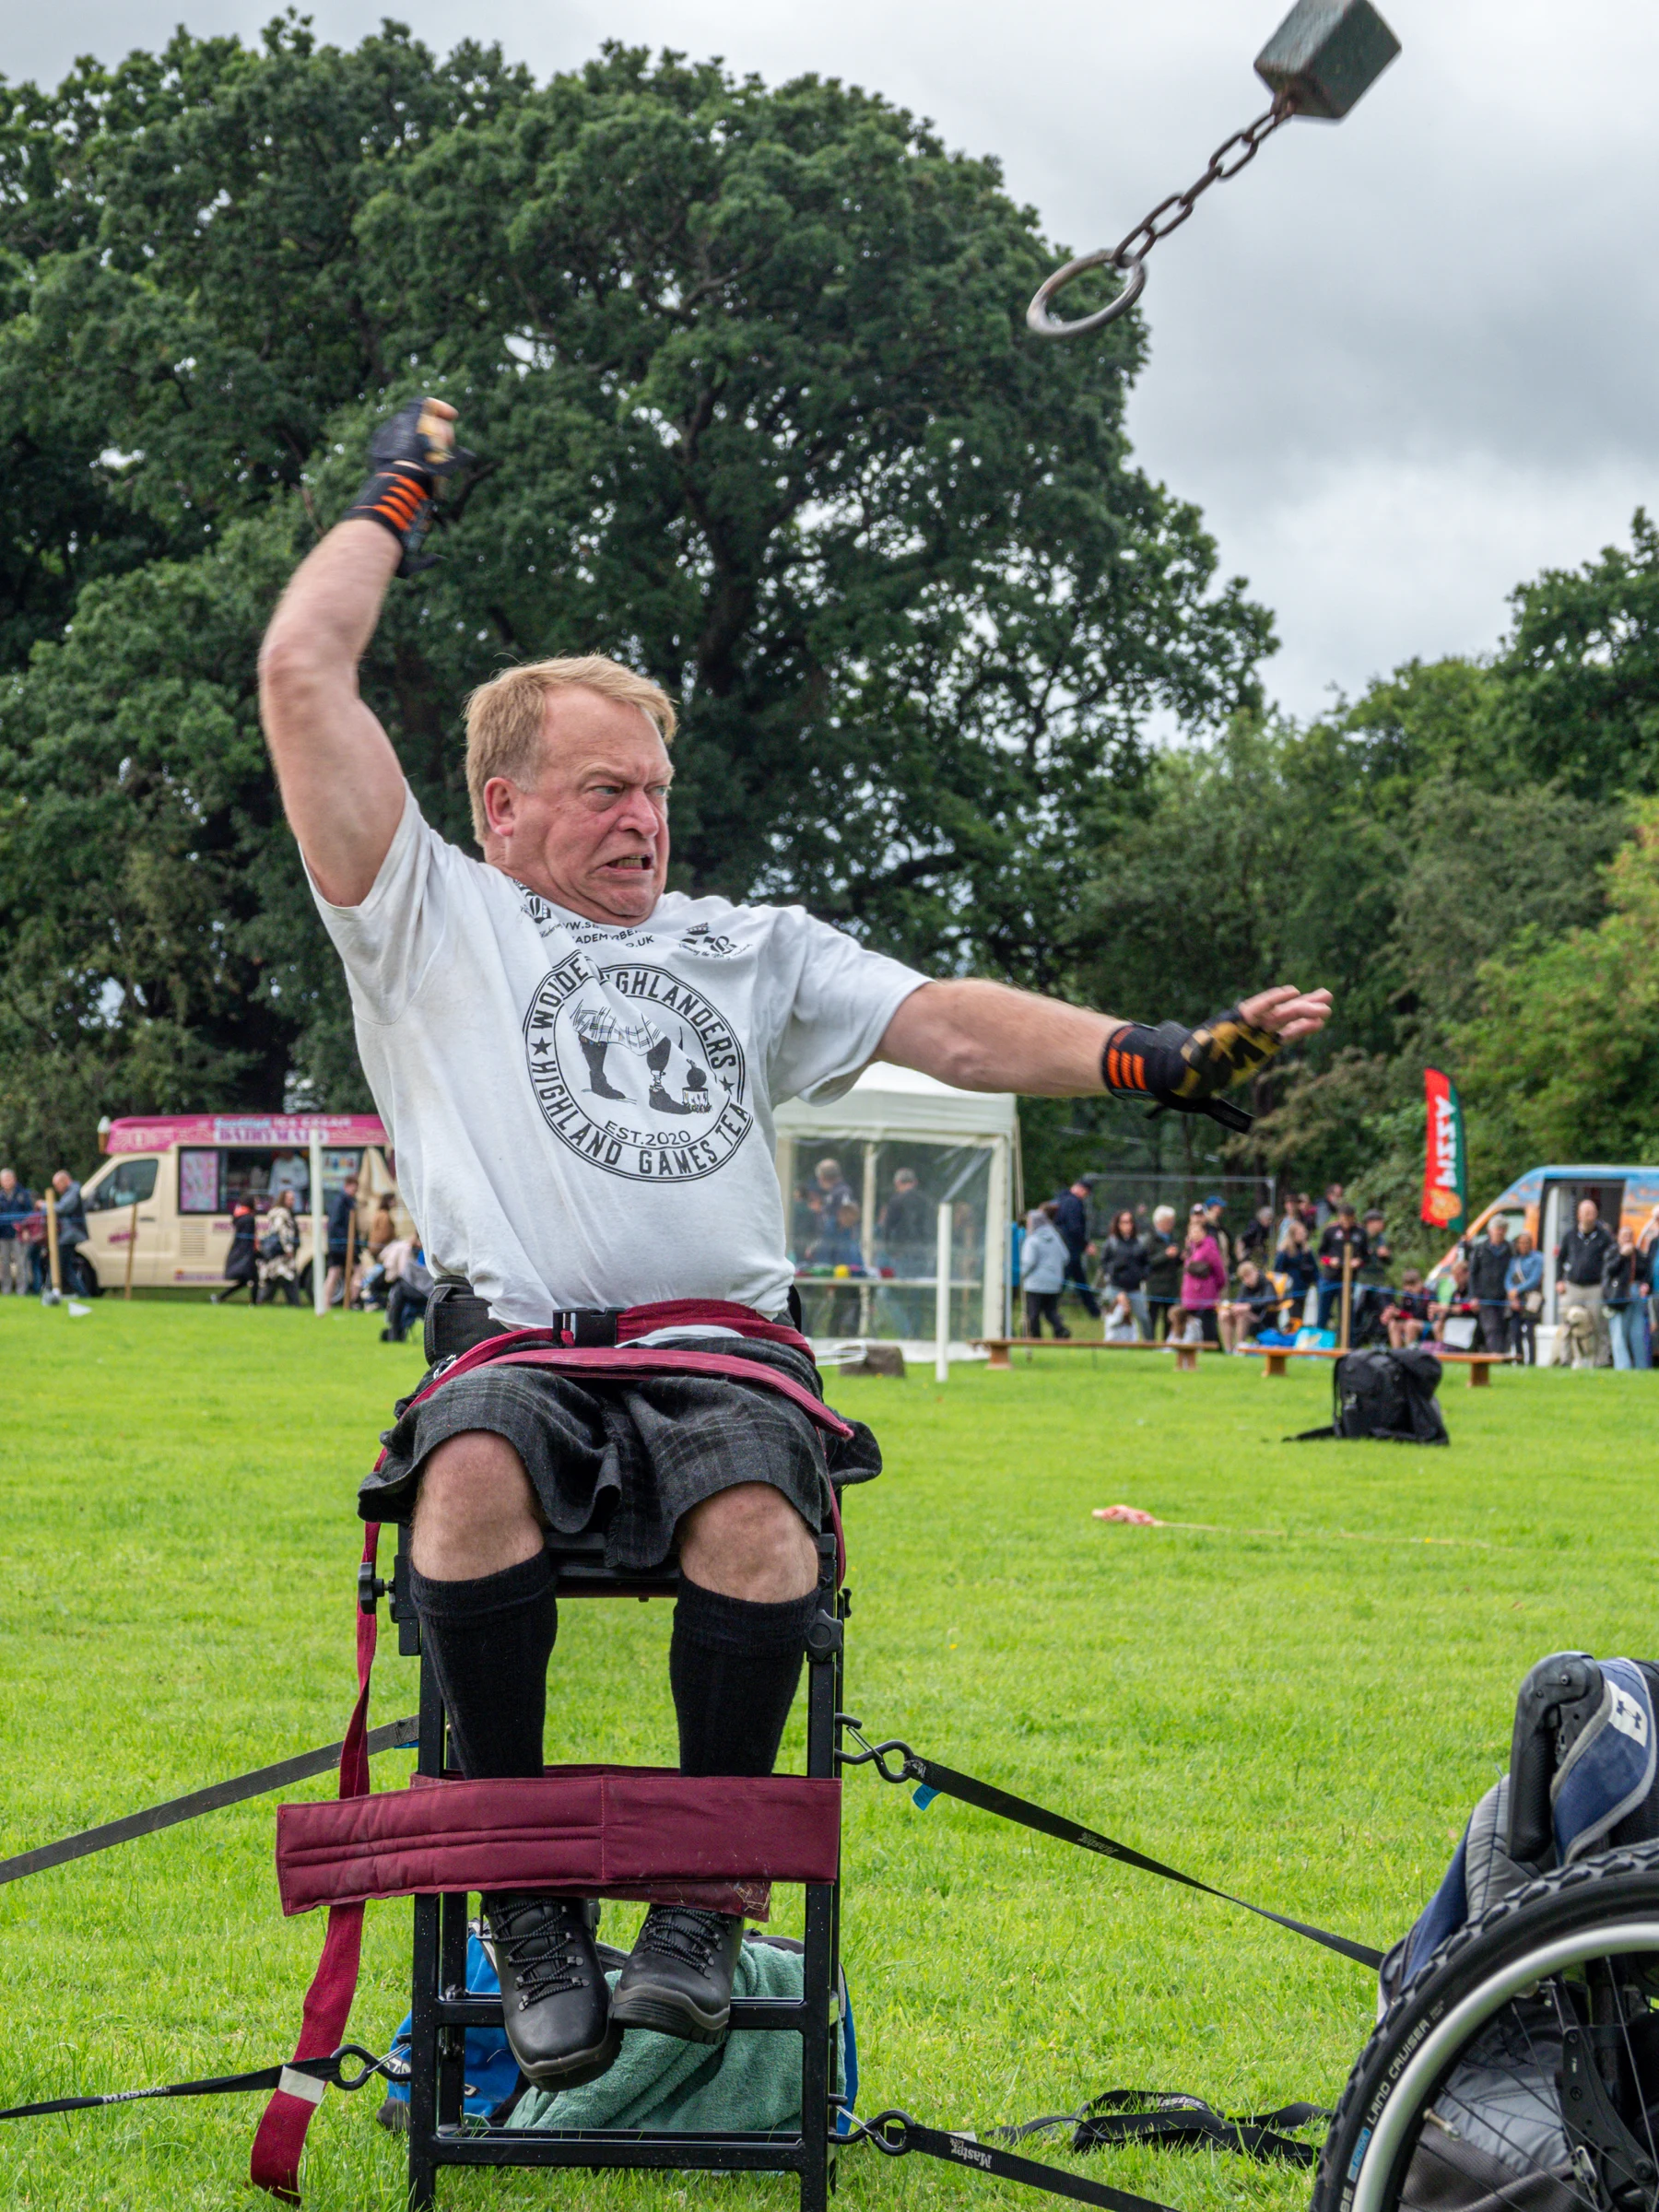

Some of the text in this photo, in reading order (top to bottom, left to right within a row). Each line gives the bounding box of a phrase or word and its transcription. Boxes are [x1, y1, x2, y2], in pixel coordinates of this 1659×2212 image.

[531, 957, 736, 1069] WODE GHLANDERS
[531, 1061, 748, 1176] HIGHLAND GAMES TEA
[605, 1120, 691, 1147] EST.2020
[1435, 1095, 1457, 1187] PIZZA
[1367, 2018, 1431, 2125] LAND CRUISER
[950, 2144, 993, 2169] Master
